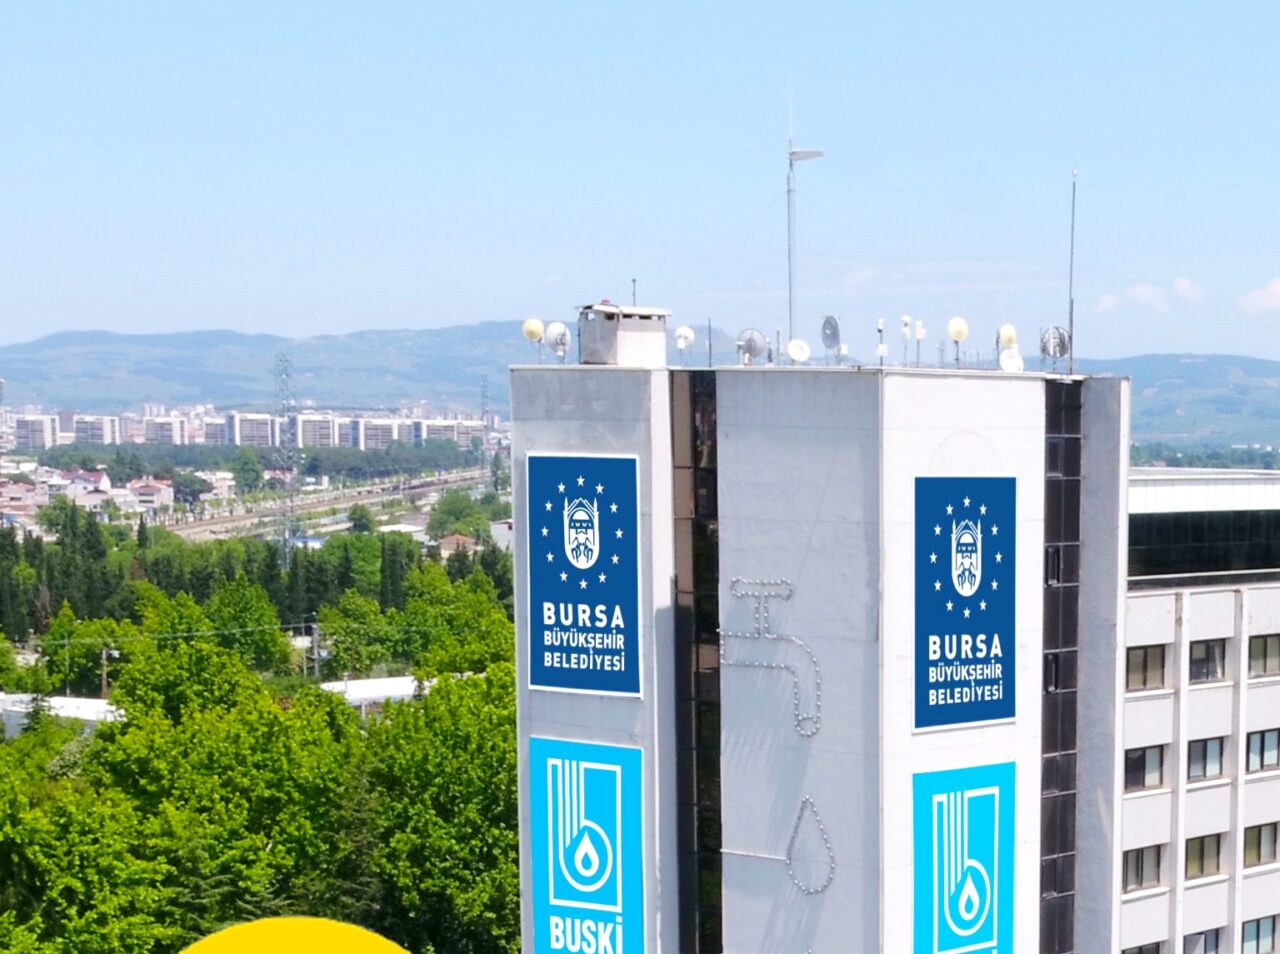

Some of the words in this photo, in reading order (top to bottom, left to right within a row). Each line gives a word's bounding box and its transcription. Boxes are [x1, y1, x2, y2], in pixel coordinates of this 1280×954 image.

[543, 602, 625, 629] BURSA
[544, 627, 625, 650] BÜYÜKŞEHİR
[928, 633, 1003, 661] BURSA
[544, 650, 625, 672] BELEDİYESİ
[928, 659, 1003, 684] BÜYÜKŞEHİR
[928, 680, 1003, 706] BELEDİYESİ
